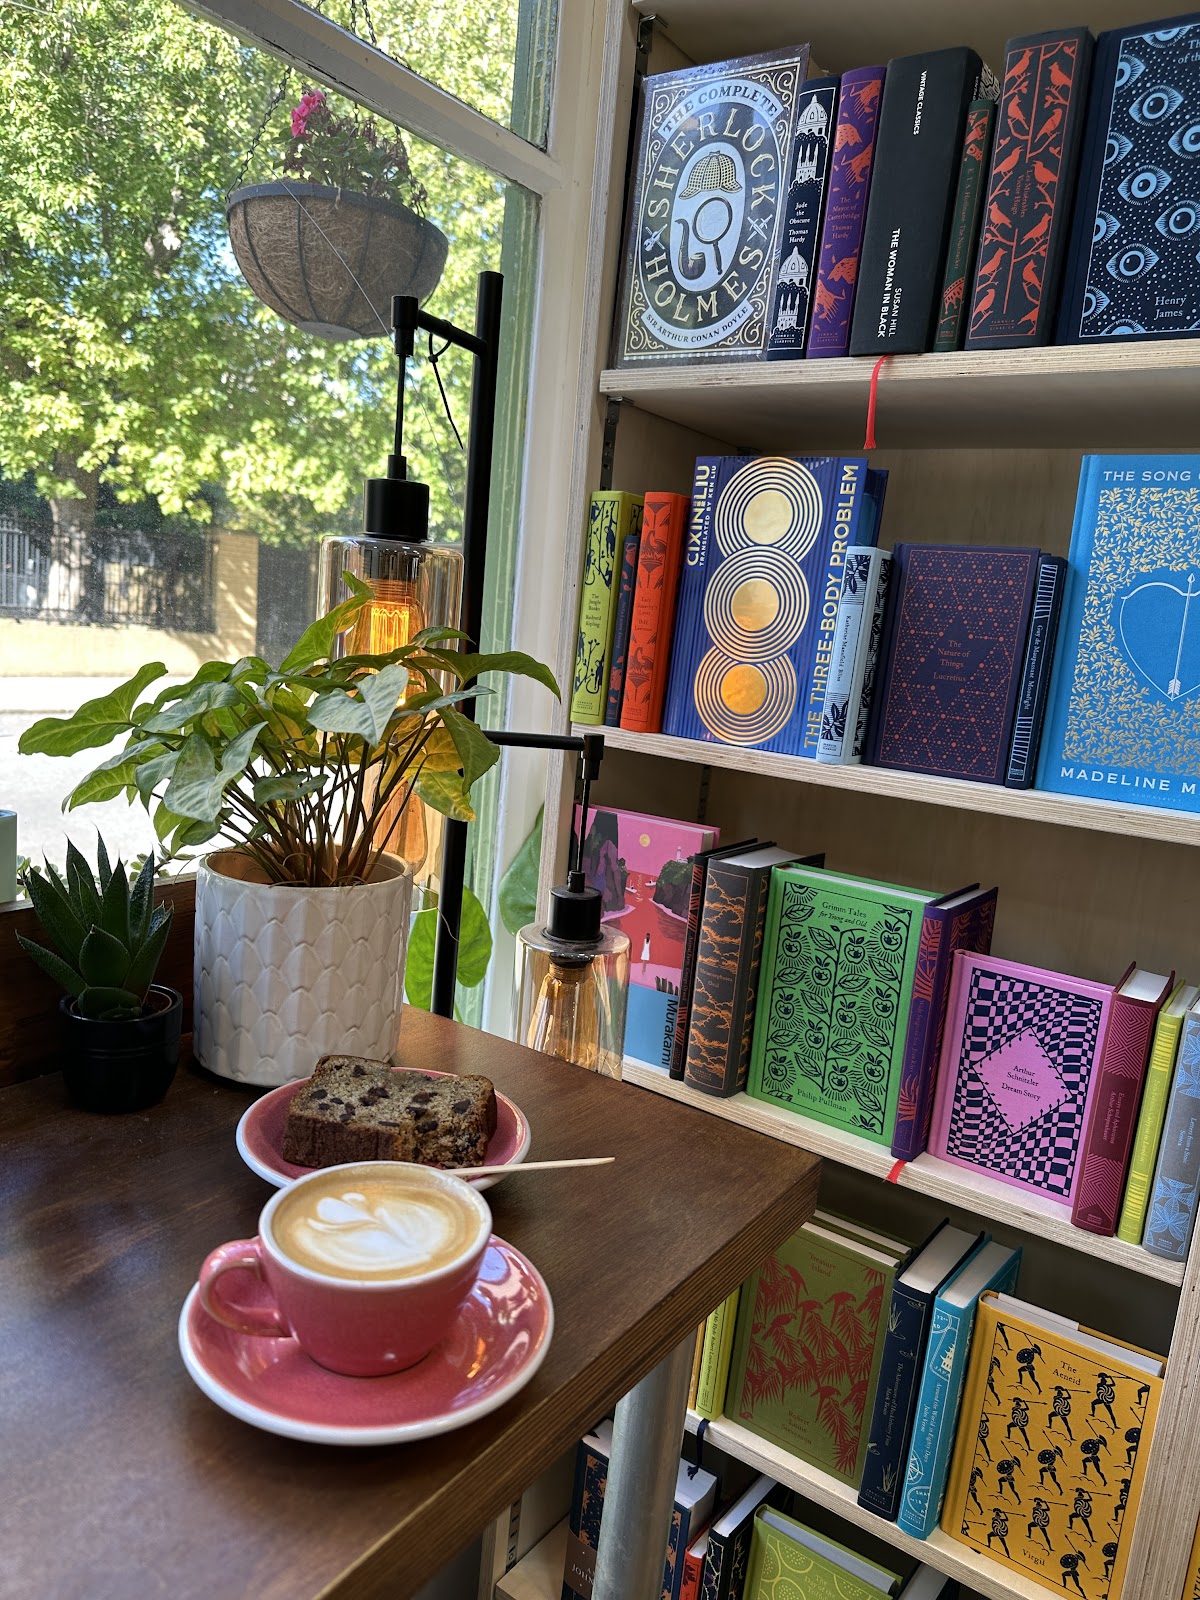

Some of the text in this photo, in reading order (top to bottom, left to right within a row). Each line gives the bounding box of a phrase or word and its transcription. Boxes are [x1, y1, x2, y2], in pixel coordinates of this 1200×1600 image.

[1178, 52, 1190, 64] of
[662, 85, 778, 133] THE COMPLETE
[913, 70, 927, 135] VINTAGE CLASSICS
[648, 107, 776, 218] SHERLOCK
[1025, 170, 1033, 181] Les
[1011, 174, 1025, 215] Victor Hugo
[795, 202, 808, 210] Jude
[828, 212, 860, 221] Casterbridge
[645, 246, 764, 322] HOLMES
[877, 228, 900, 337] THE WOMAN IN BLACK
[1154, 296, 1187, 307] Henry
[888, 287, 902, 337] SUSAN HILL
[1153, 309, 1183, 320] James
[646, 306, 748, 343] SIR ARTHUR CONAN DOYLE
[1103, 471, 1135, 482] THE
[1141, 471, 1191, 482] SONG
[686, 465, 710, 566] CIXIN LIU
[699, 515, 710, 567] TRANSLATED
[706, 502, 712, 512] BY
[804, 465, 859, 749] THE THREE-BODY PROBLEM
[586, 620, 600, 628] Kipling
[1034, 625, 1043, 637] Guy
[948, 639, 961, 648] The
[839, 641, 848, 667] Mansfield
[937, 648, 971, 658] Nature of
[1030, 645, 1040, 678] Maupassant
[940, 659, 964, 670] Things
[933, 671, 966, 682] Lucretius
[1023, 680, 1035, 710] Moonlight
[1060, 766, 1171, 791] MADELINE
[818, 910, 827, 918] for
[828, 913, 843, 924] Young
[855, 919, 868, 928] Old
[822, 901, 867, 919] Grimm Tales
[708, 980, 719, 989] Ovid
[661, 999, 679, 1067] Murakami
[1007, 1071, 1039, 1087] Schnitzler
[1013, 1065, 1036, 1077] Arthur
[797, 1088, 847, 1111] Philip Pullman
[1001, 1082, 1041, 1102] Dream Story
[1116, 1092, 1125, 1109] Essays
[1102, 1091, 1117, 1141] Arthur Schopenhauer
[1146, 1112, 1154, 1132] Calypso
[1188, 1117, 1197, 1134] Letters
[1177, 1129, 1186, 1147] Seneca
[1140, 1141, 1150, 1162] London
[1183, 1151, 1191, 1164] Stoic
[809, 1252, 836, 1270] Treasure
[811, 1262, 831, 1277] Island
[1060, 1360, 1077, 1374] The
[893, 1371, 902, 1400] Adventures
[1052, 1368, 1081, 1386] Aeneid
[788, 1410, 809, 1425] Robert
[789, 1419, 807, 1433] Louis
[888, 1403, 897, 1435] Huckleberry
[920, 1417, 928, 1433] Verne
[930, 1410, 938, 1428] World
[781, 1423, 812, 1445] Stevenson
[925, 1432, 934, 1452] Eighty
[1022, 1549, 1045, 1566] Virgil
[805, 1576, 817, 1589] Day
[825, 1590, 836, 1599] the
[816, 1575, 827, 1587] The
